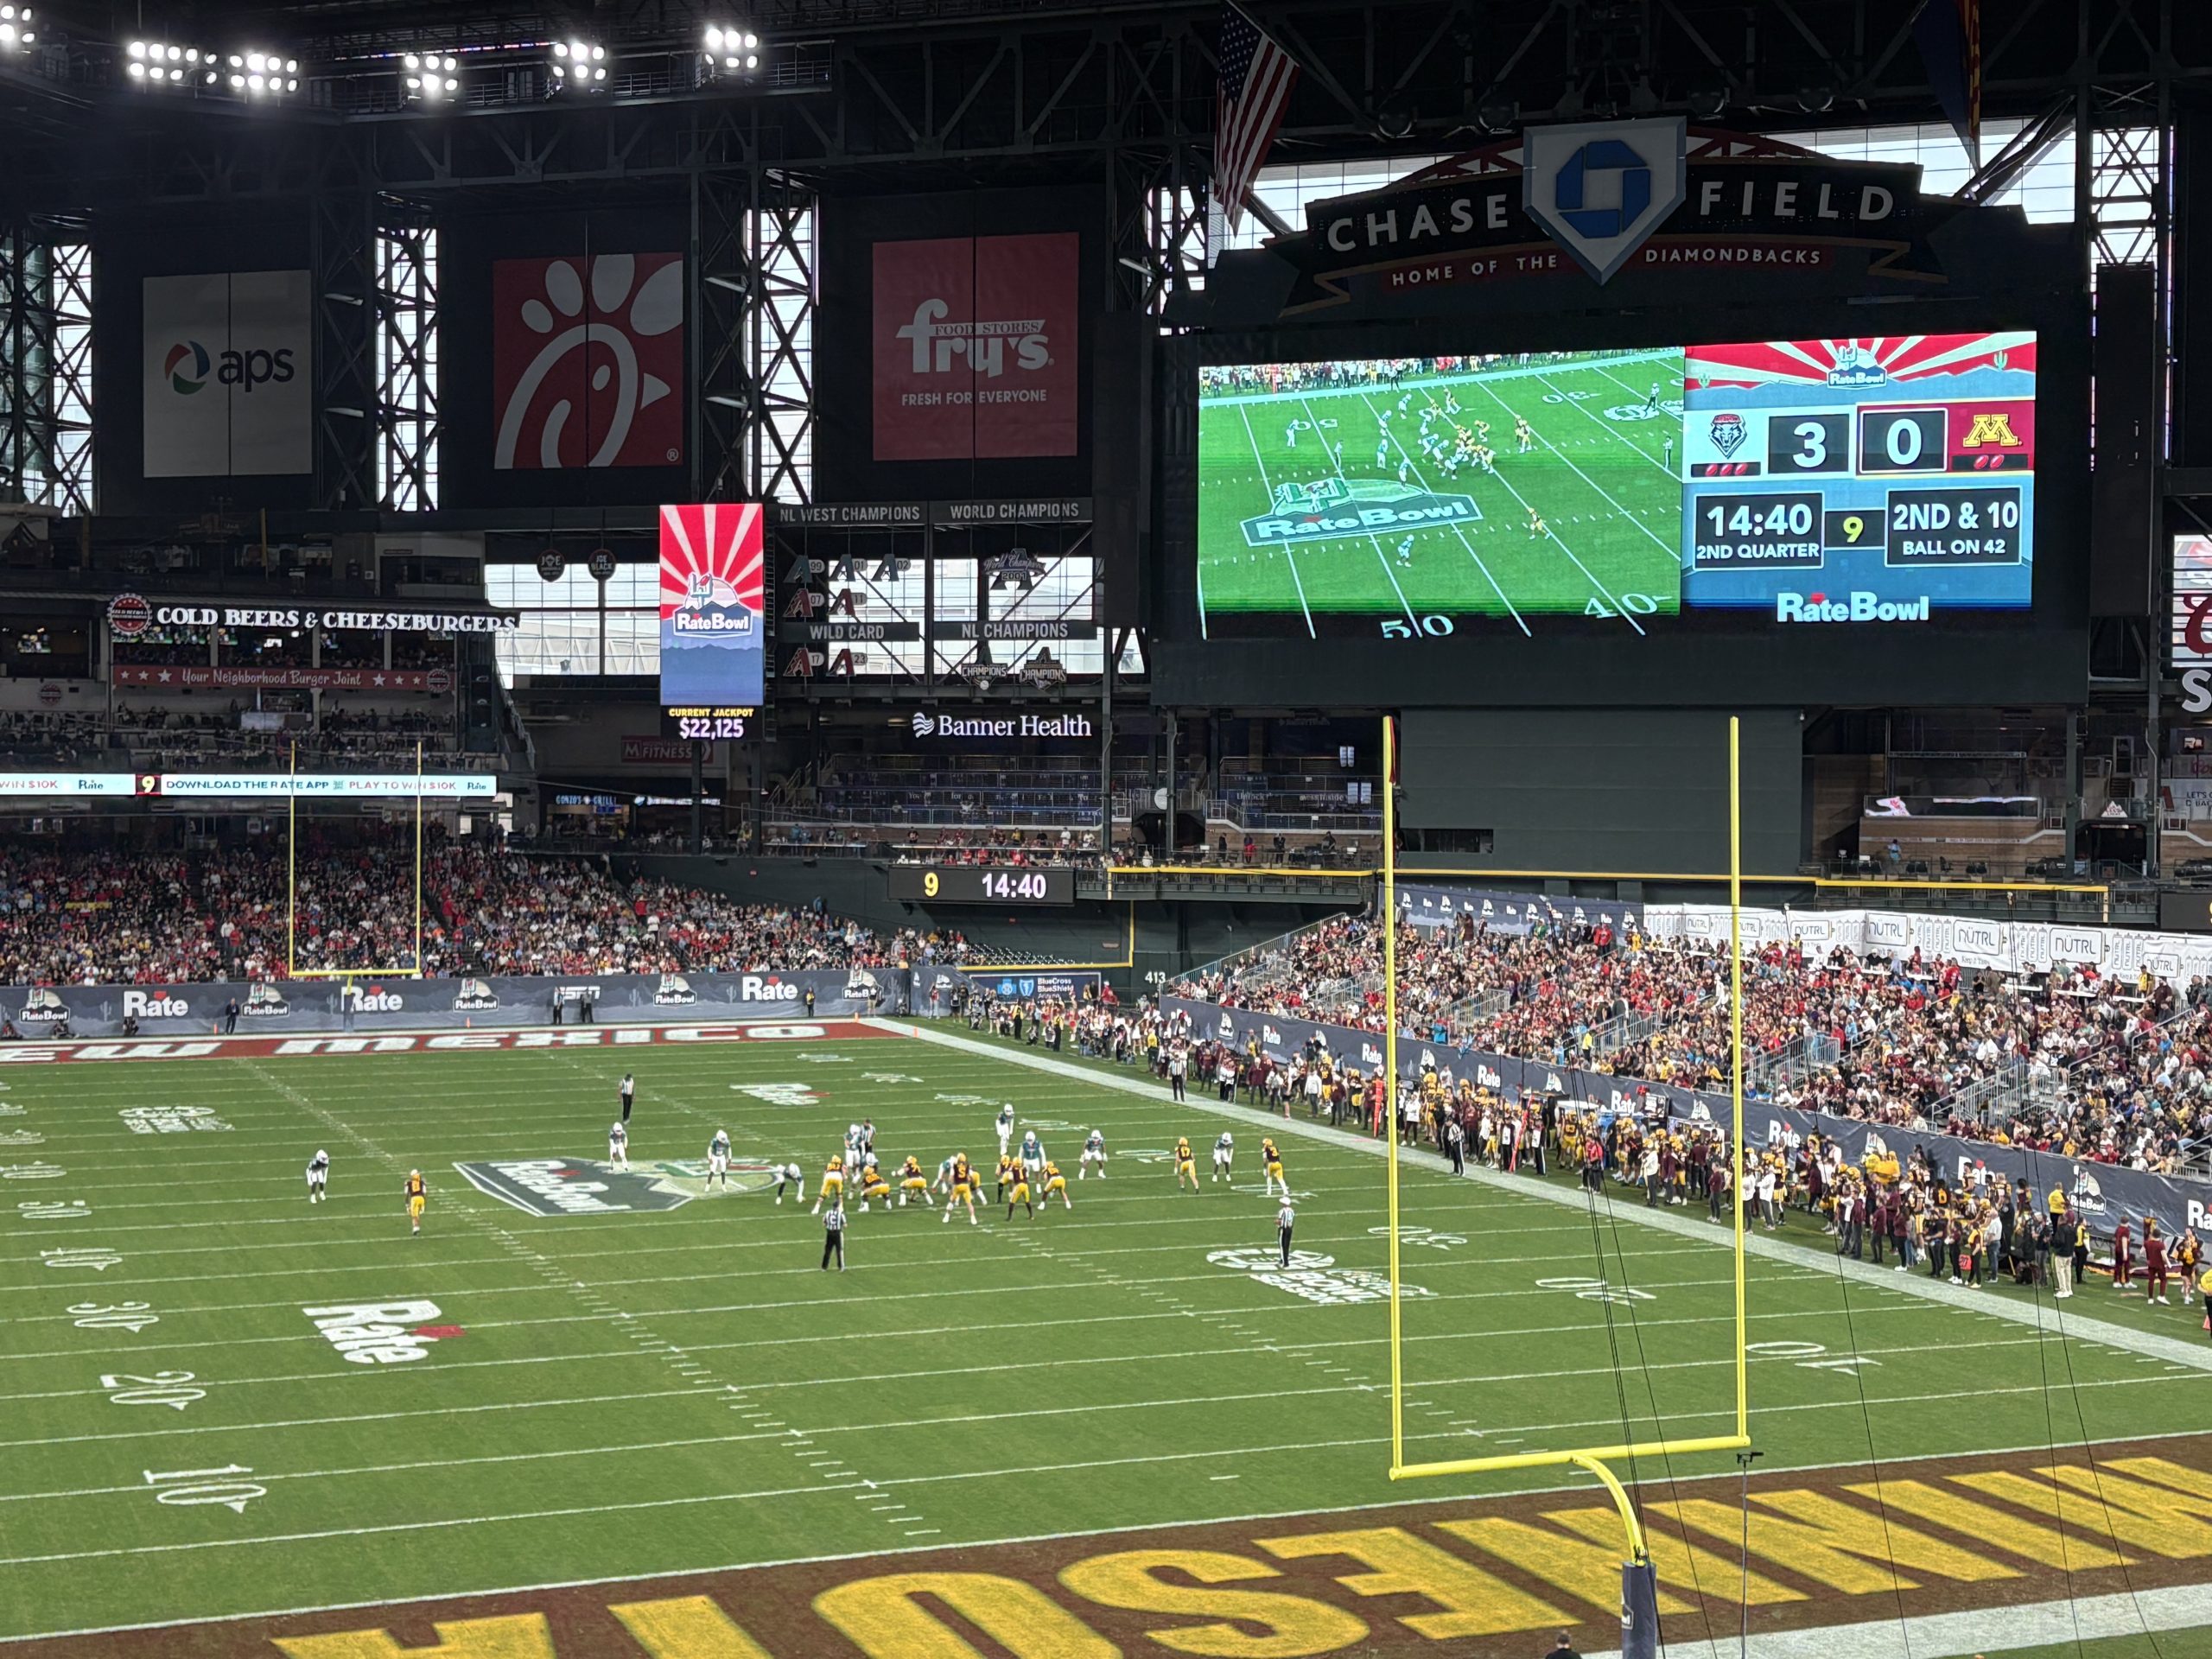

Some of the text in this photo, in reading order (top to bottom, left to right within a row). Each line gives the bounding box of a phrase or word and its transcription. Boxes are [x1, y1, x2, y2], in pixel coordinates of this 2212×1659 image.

[1327, 181, 1893, 251] CHASE FIELD
[1392, 249, 1820, 286] HOME OF THE DIAMONDBACKS
[936, 322, 1039, 335] FOOD STORES
[896, 299, 1049, 378] fry's
[217, 346, 295, 392] aps
[902, 390, 1047, 406] FRESH FOR EVERYONE
[1793, 422, 1827, 467] 3
[1886, 418, 1922, 464] 0
[780, 506, 920, 522] NL WEST CHAMPIONS
[950, 503, 1079, 518] WORLD CHAMPIONS
[1893, 501, 2018, 531] 2ND & 10
[1256, 500, 1469, 539] RateBowl
[1707, 504, 1812, 537] 14:40
[1842, 517, 1864, 543] 9
[1696, 543, 1820, 560] 2ND QUARTER
[1903, 539, 2005, 556] BALL ON 42
[854, 560, 864, 570] 01
[897, 560, 908, 569] 02
[1001, 571, 1027, 582] 2001
[810, 594, 821, 604] 07
[1777, 591, 1929, 622] RateBowl
[157, 607, 218, 626] COLD
[224, 608, 300, 627] BEERS
[304, 612, 319, 628] &
[322, 612, 516, 632] CHEESEBURGERS
[677, 613, 748, 630] RateBowl
[810, 626, 885, 639] WILD CARD
[962, 623, 1068, 639] NL CHAMPIONS
[181, 669, 361, 686] Your Neighborhood Burger Joint
[962, 665, 1007, 677] CHAMPIONS
[1020, 669, 1066, 683] CHAMPIONS
[668, 709, 753, 717] CURRENT JACKPOT
[679, 718, 744, 740] $22,125
[938, 715, 1092, 736] Banner Health
[642, 747, 693, 760] FITNESS
[29, 780, 58, 789] $10K
[142, 776, 156, 793] 9
[166, 780, 241, 789] DOWNLOAD
[245, 780, 268, 789] THE
[925, 872, 1046, 899] 9 14:40
[1145, 971, 1166, 983] 413
[742, 976, 798, 1001] Rate
[844, 988, 882, 1000] RateB
[124, 991, 188, 1017] Rate
[341, 986, 403, 1012] Rate
[455, 1000, 497, 1010] RateBowl
[656, 995, 696, 1004] RateBowl
[22, 1011, 68, 1020] RateBowl
[244, 1005, 288, 1016] RateBowl
[1363, 1044, 1382, 1065] Rate
[1478, 1065, 1501, 1088] Rate
[66, 1300, 160, 1327] 30
[302, 1300, 442, 1363] Rate
[100, 1370, 207, 1405] 20
[143, 1464, 266, 1505] 10
